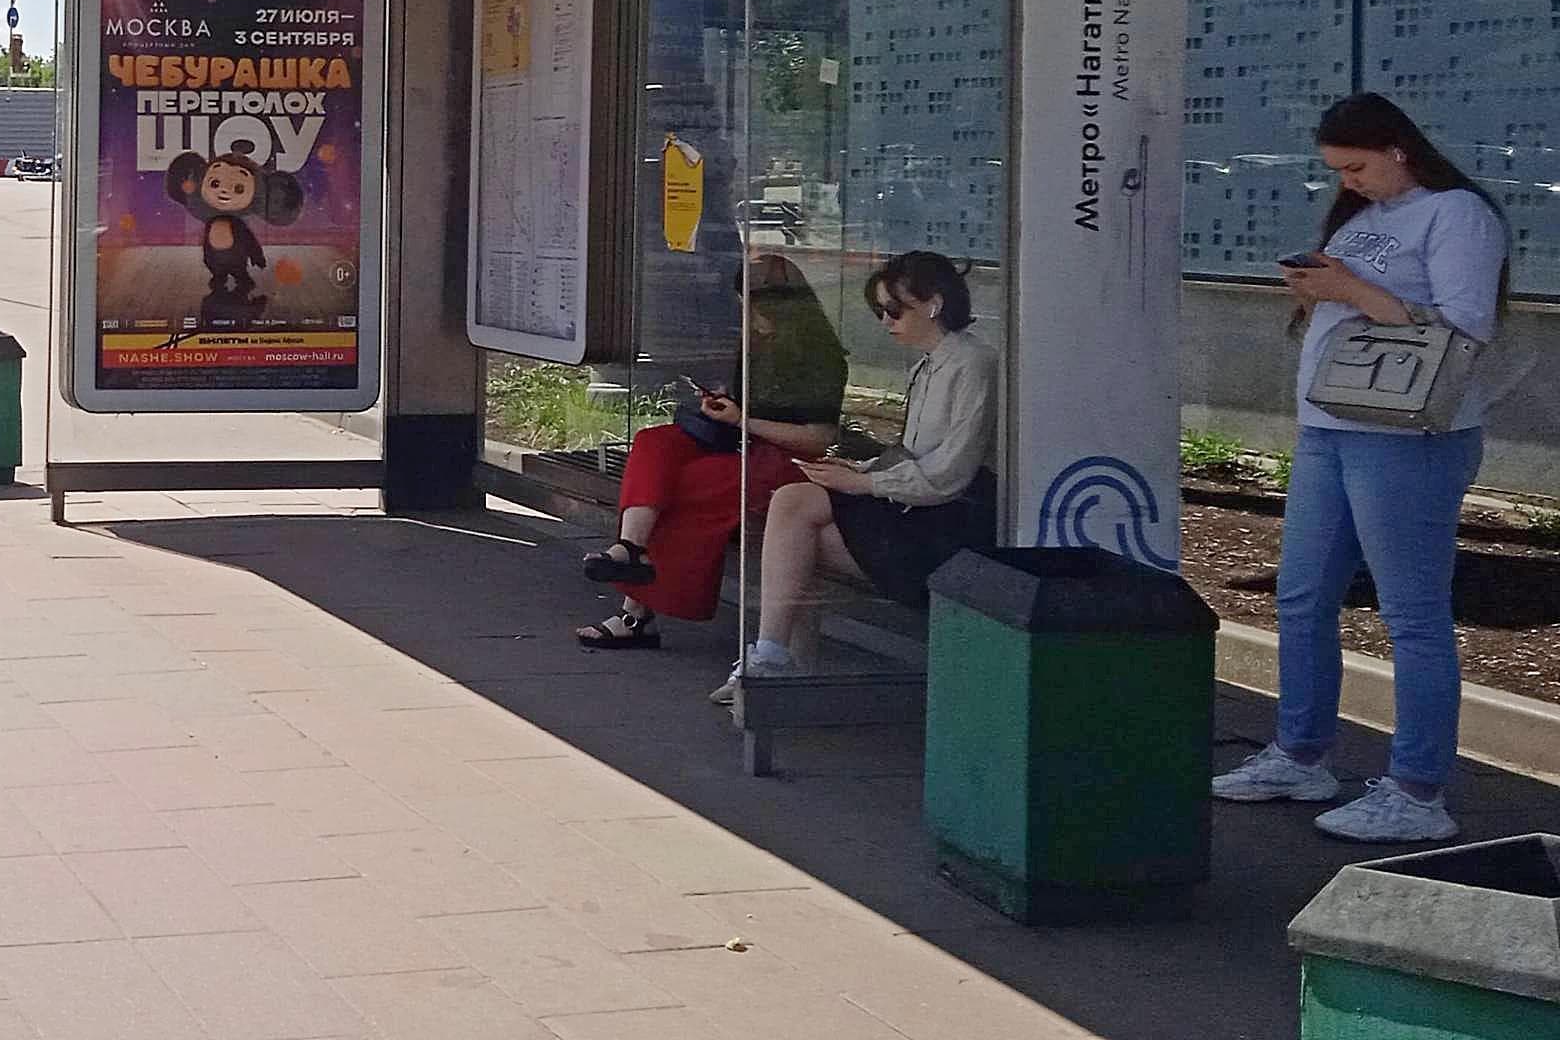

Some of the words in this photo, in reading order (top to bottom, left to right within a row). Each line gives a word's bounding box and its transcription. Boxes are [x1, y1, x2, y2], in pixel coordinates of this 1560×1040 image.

[255, 8, 276, 23] 27
[105, 18, 212, 38] МОСКВА
[234, 31, 248, 46] 3
[250, 31, 355, 47] СЕНТЯБРЯ
[108, 54, 352, 90] ЧЕБУРАШКА
[1112, 26, 1130, 101] Metro
[136, 90, 327, 115] ПЕРЕПОЛОХ
[136, 114, 327, 173] ШОУ
[1074, 124, 1104, 232] Метро
[118, 351, 219, 364] NASHE.SHOW
[265, 350, 345, 362] moscow-hall.ru
